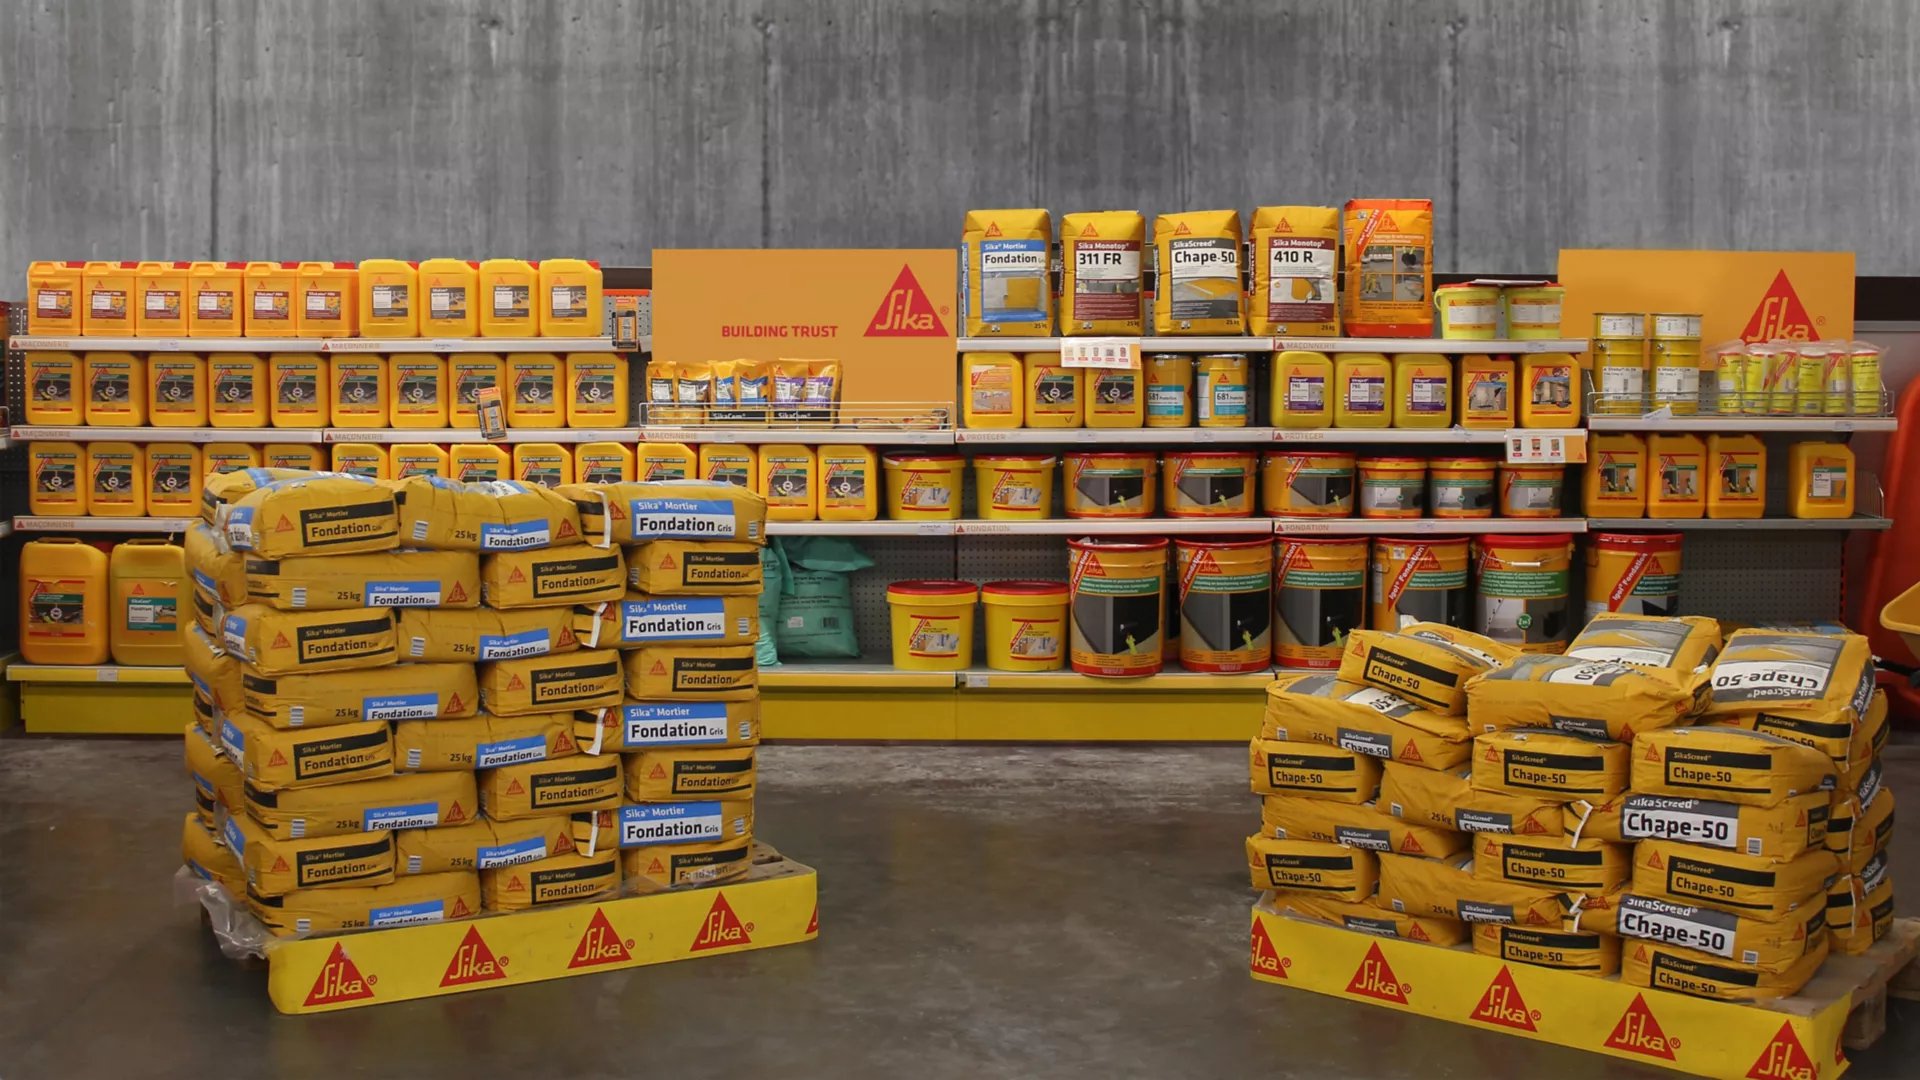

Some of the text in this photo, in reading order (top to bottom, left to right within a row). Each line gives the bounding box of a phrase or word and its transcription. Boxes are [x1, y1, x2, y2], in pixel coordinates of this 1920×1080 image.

[985, 254, 1037, 263] Fondation
[1080, 253, 1121, 265] 311 FR
[1175, 251, 1234, 265] Chape-50
[1275, 251, 1312, 262] 410 R
[722, 326, 838, 337] BUILDING TRUST
[665, 502, 698, 511] Mortier
[312, 522, 371, 537] Fondation
[640, 518, 732, 532] Fondation Gris
[455, 530, 477, 541] 25 kg
[1400, 544, 1424, 581] Fondation
[1623, 552, 1648, 586] Fondation
[691, 569, 740, 578] Fondation
[542, 577, 595, 589] Fondation
[338, 592, 360, 602] 25 kg
[374, 596, 424, 605] Fondation
[653, 603, 686, 612] Mortier
[630, 618, 704, 633] Fondation
[308, 640, 367, 654] Fondation
[454, 644, 475, 655] 25 kg
[488, 647, 536, 658] Fondation
[682, 674, 731, 685] Fondation
[1372, 666, 1420, 689] Chape-50
[1717, 670, 1818, 688] Chape-50
[540, 682, 594, 696] Fondation
[347, 709, 358, 719] kg
[372, 709, 422, 719] Fondation
[657, 707, 690, 716] Mortier
[632, 723, 706, 738] Fondation
[305, 754, 364, 770] Fondation
[450, 753, 472, 763] 25 kg
[485, 752, 532, 765] Fondation
[681, 777, 731, 787] Fondation
[1276, 771, 1322, 783] Chape-50
[1512, 768, 1566, 785] Chape-50
[1674, 768, 1731, 783] Chape-50
[540, 788, 594, 800] Fondation
[652, 807, 685, 815] Mortier
[337, 820, 359, 830] 25 kg
[372, 819, 423, 829] Fondation
[1627, 814, 1728, 841] Chape-50
[627, 824, 718, 839] Fondation Gris
[451, 858, 473, 868] 25 kg
[485, 854, 532, 868] Fondation
[307, 863, 366, 878] Fondation
[1511, 862, 1565, 879] Chape-50
[1276, 871, 1321, 884] Chape-50
[541, 884, 593, 898] Fondation
[1676, 877, 1734, 897] Chape-50
[1625, 914, 1725, 951] Chape-50
[1509, 946, 1563, 962] Chape-50
[1659, 973, 1716, 994] Chape-50
